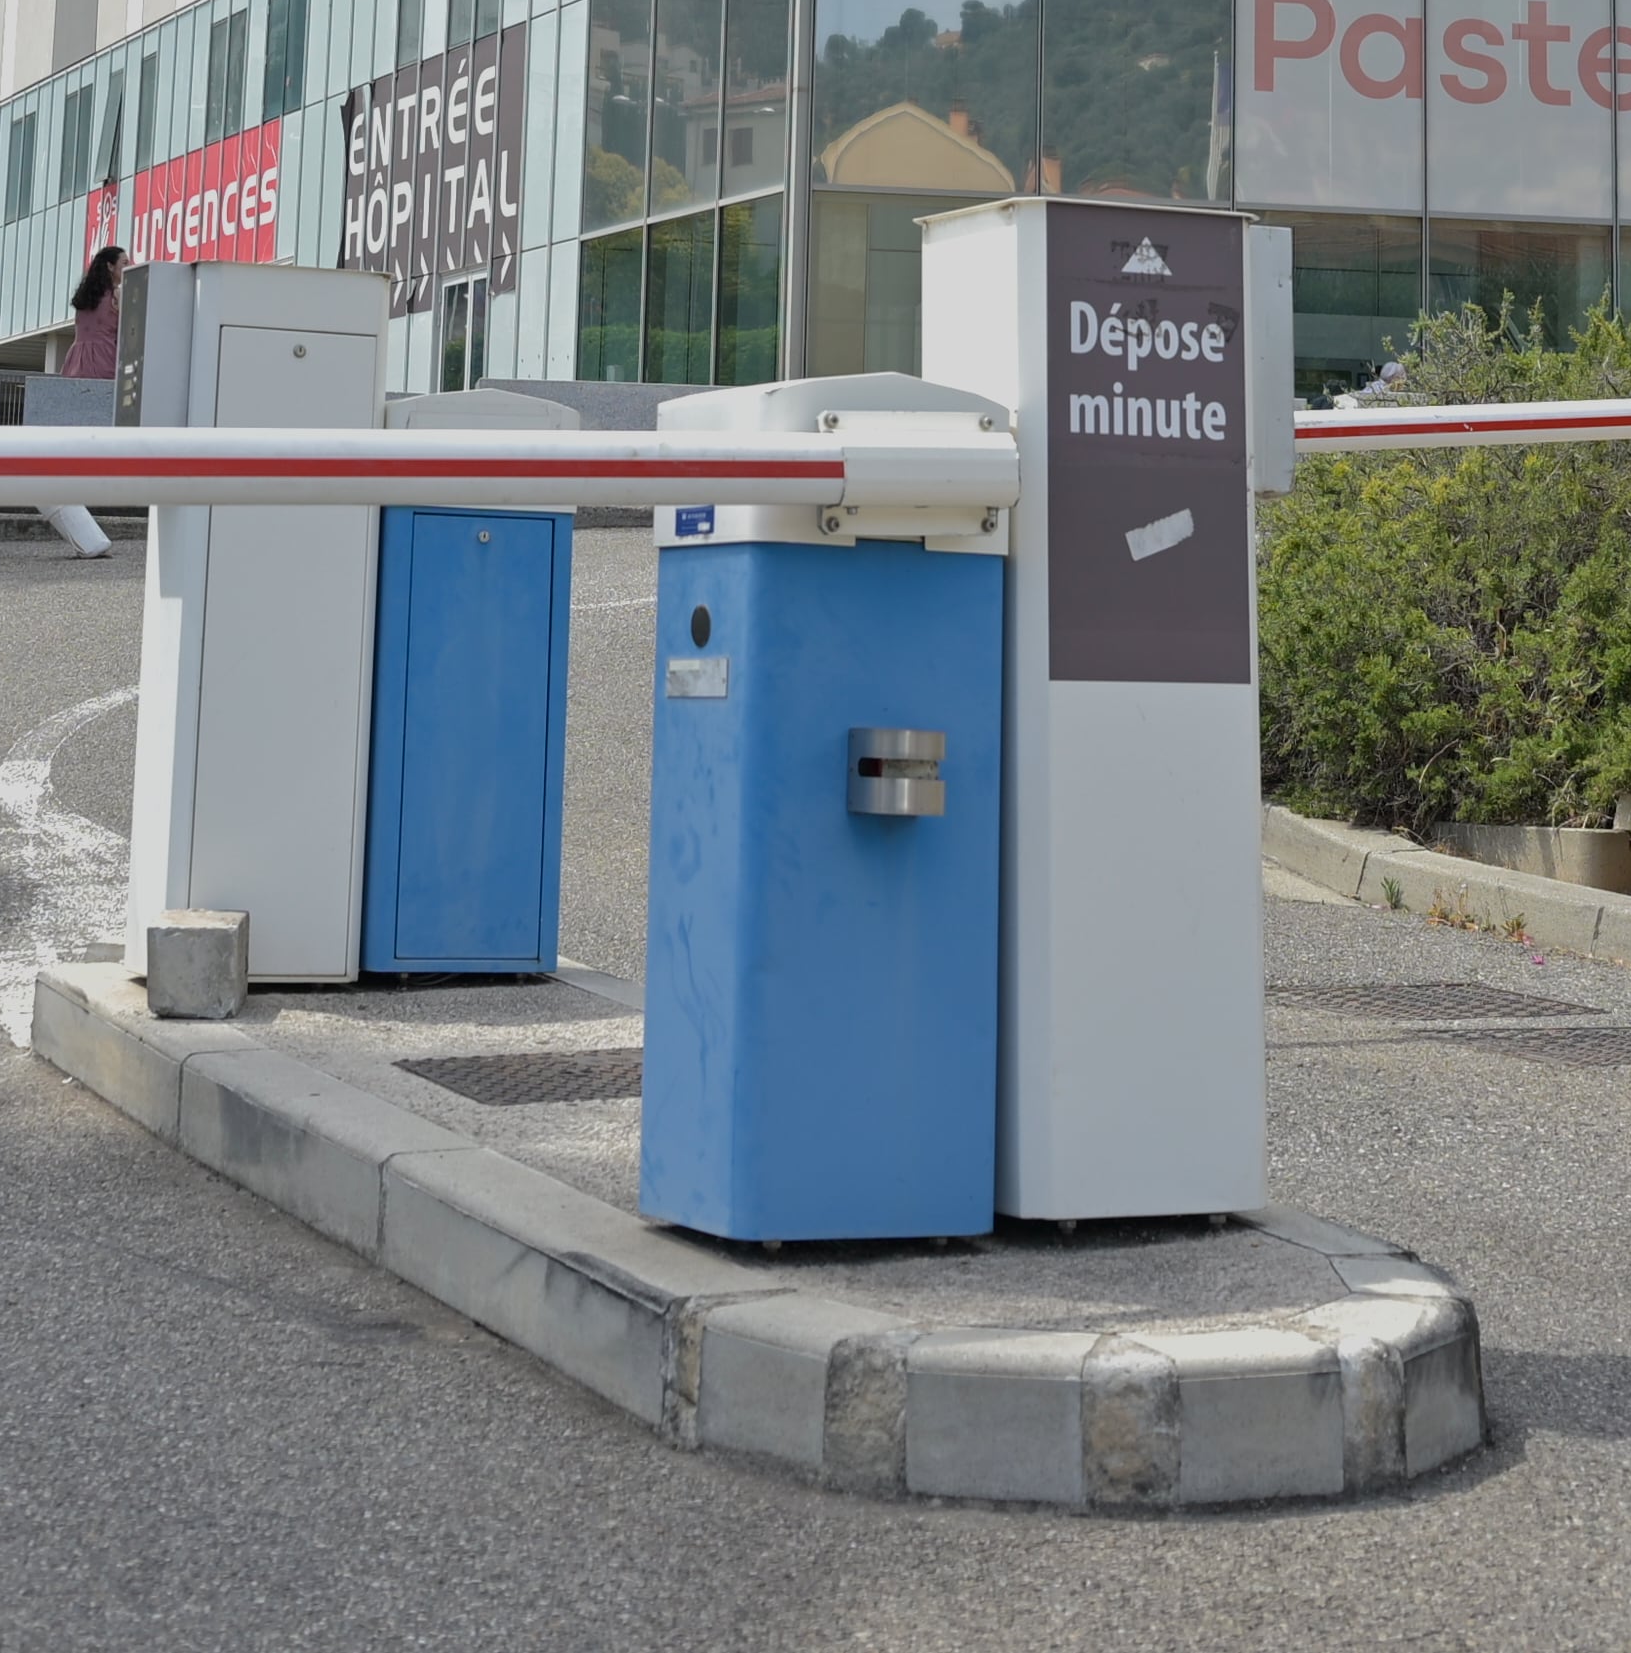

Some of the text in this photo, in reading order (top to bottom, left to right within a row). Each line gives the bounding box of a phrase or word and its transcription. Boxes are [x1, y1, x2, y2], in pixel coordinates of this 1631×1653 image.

[349, 58, 496, 176] ENTRÉE
[344, 150, 517, 260] HÔPITAL
[1070, 300, 1226, 371] Dépose
[1070, 381, 1227, 441] minute
